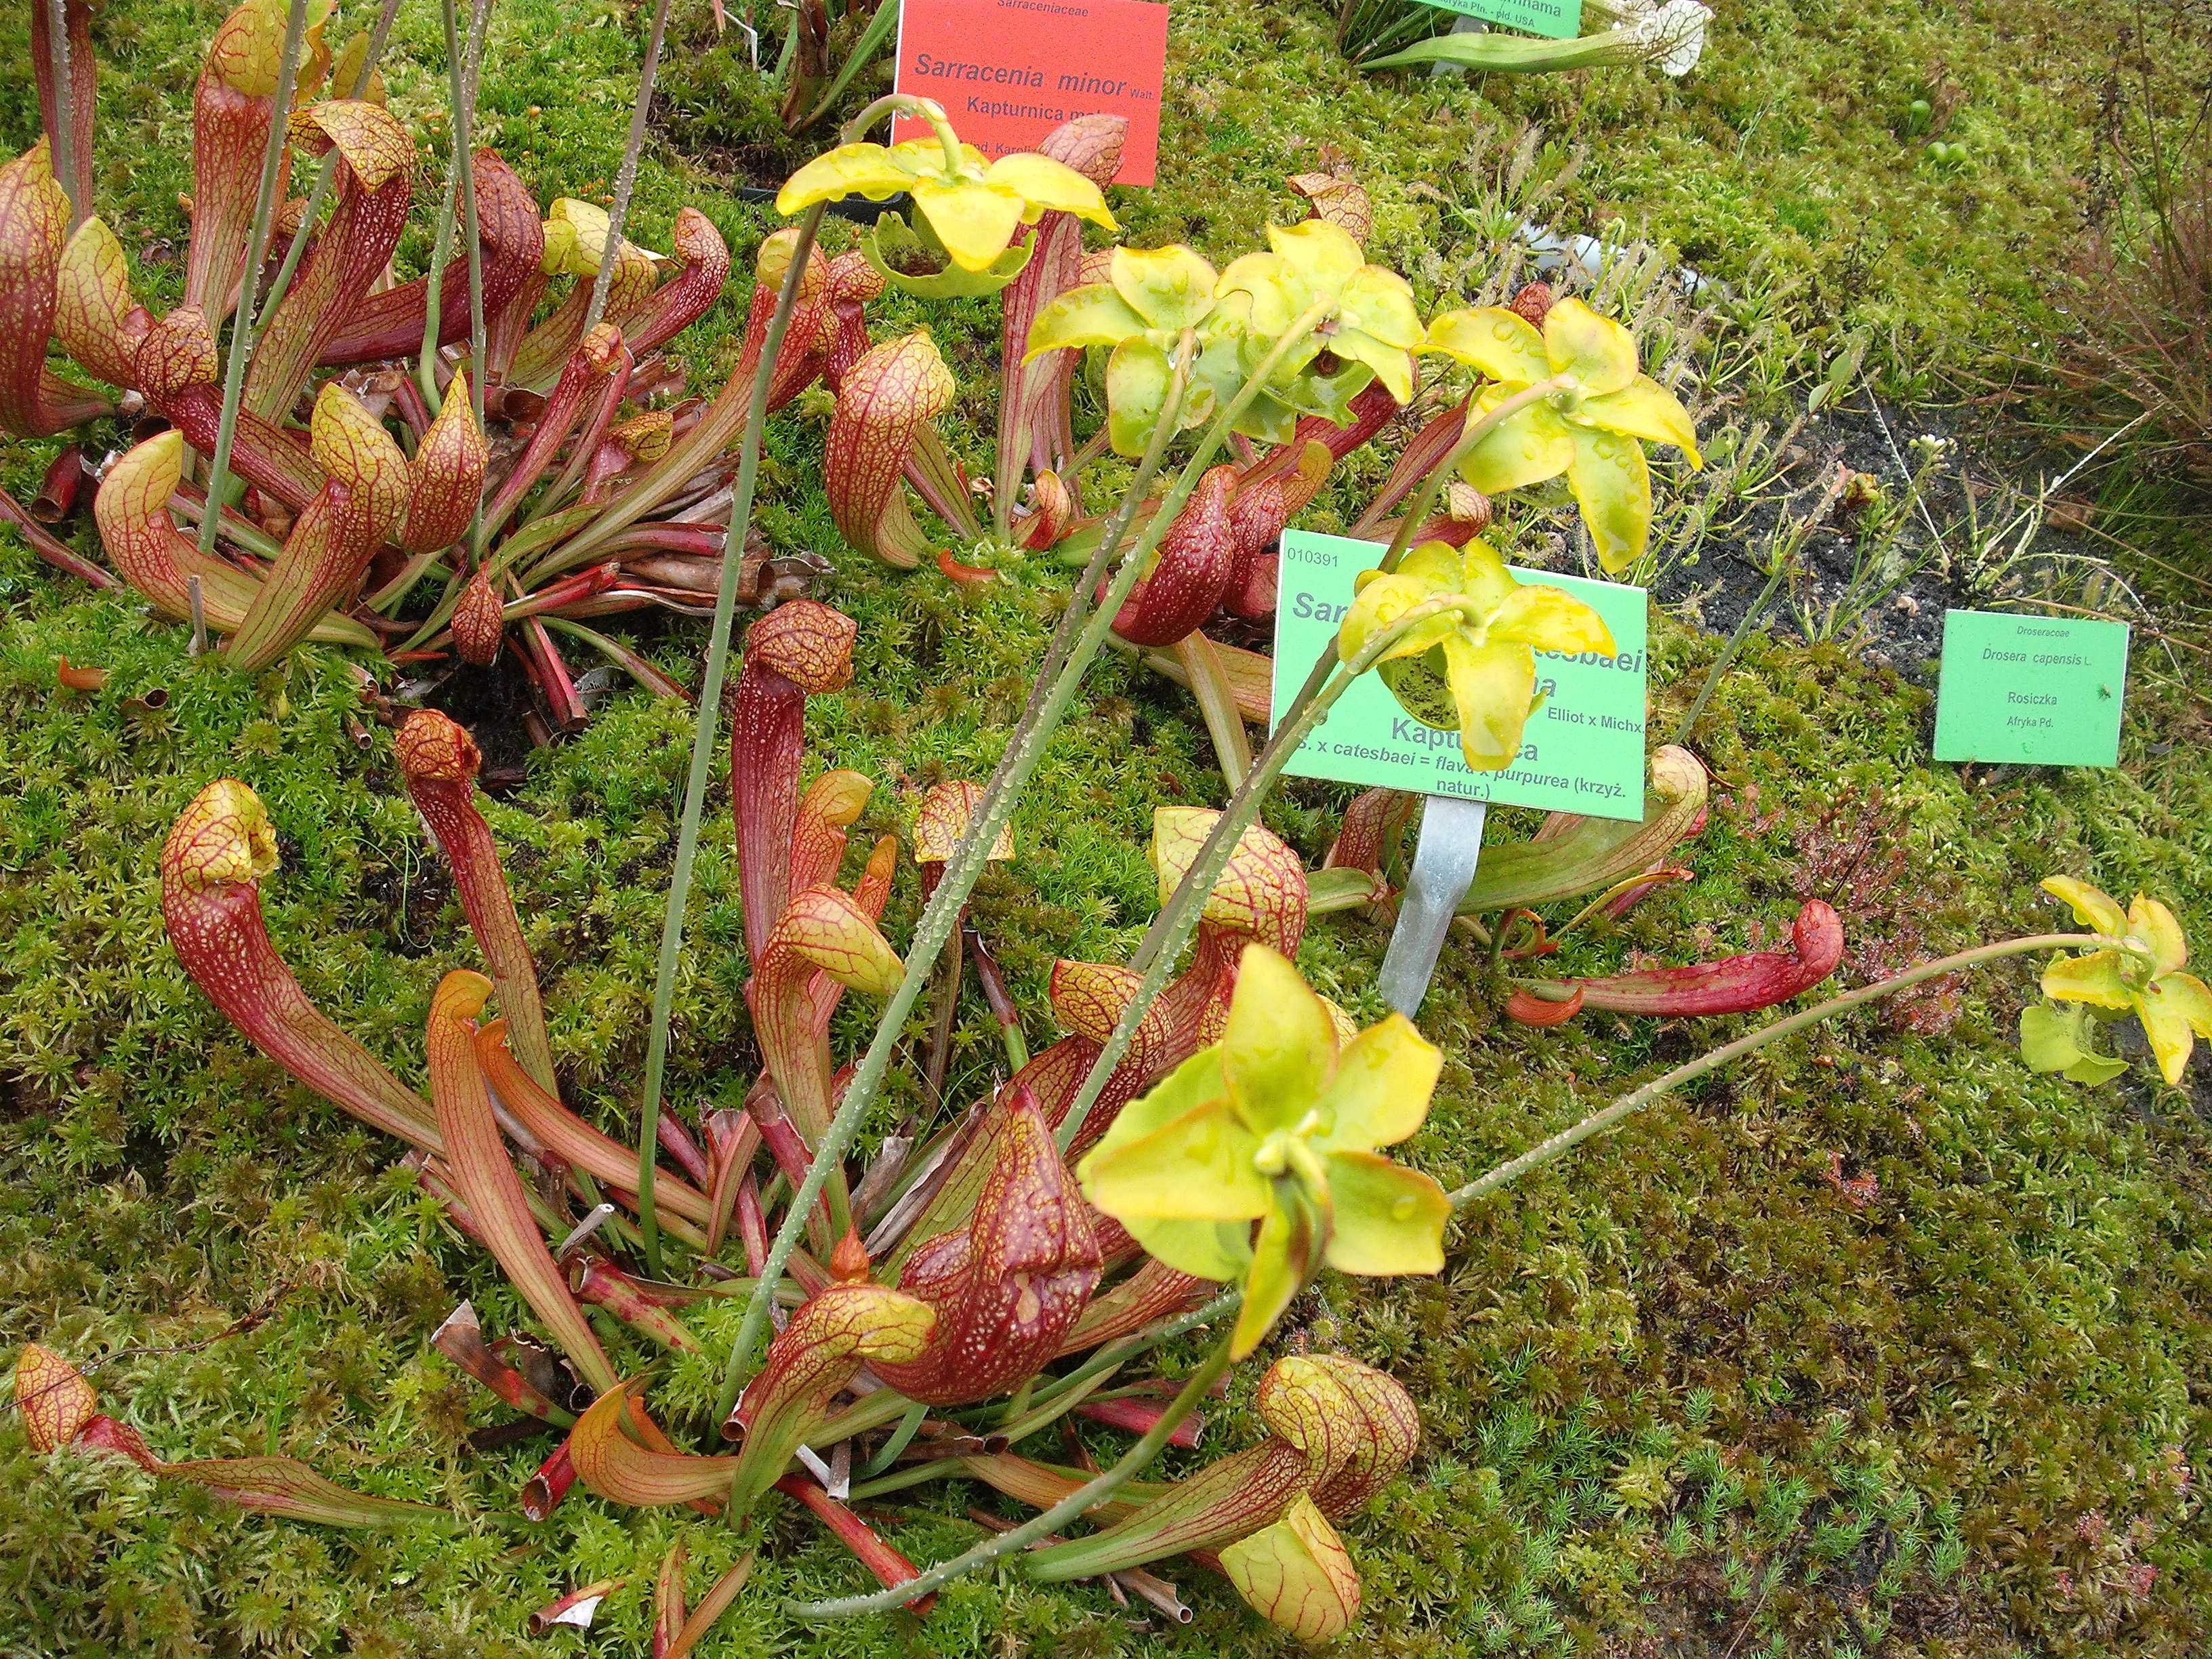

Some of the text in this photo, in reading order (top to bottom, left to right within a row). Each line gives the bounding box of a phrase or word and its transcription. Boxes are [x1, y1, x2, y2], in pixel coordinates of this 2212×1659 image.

[1515, 15, 1535, 27] USA
[915, 54, 1044, 87] Sarracenia
[1057, 71, 1127, 96] minor
[967, 96, 1063, 120] Kapturnica
[1288, 548, 1338, 567] 010391
[1982, 648, 2027, 662] Drosera
[2033, 654, 2082, 666] capensis
[2007, 691, 2057, 705] Rosiczka
[1548, 707, 1645, 734] Elliot x Michx.
[2007, 716, 2054, 729] Afryka Pd.
[1317, 741, 1328, 752] x
[1333, 743, 1416, 765] catesbaei
[1494, 767, 1570, 788] purpurea
[1574, 777, 1626, 798] (krzyż.
[1436, 780, 1491, 800] natur.)
